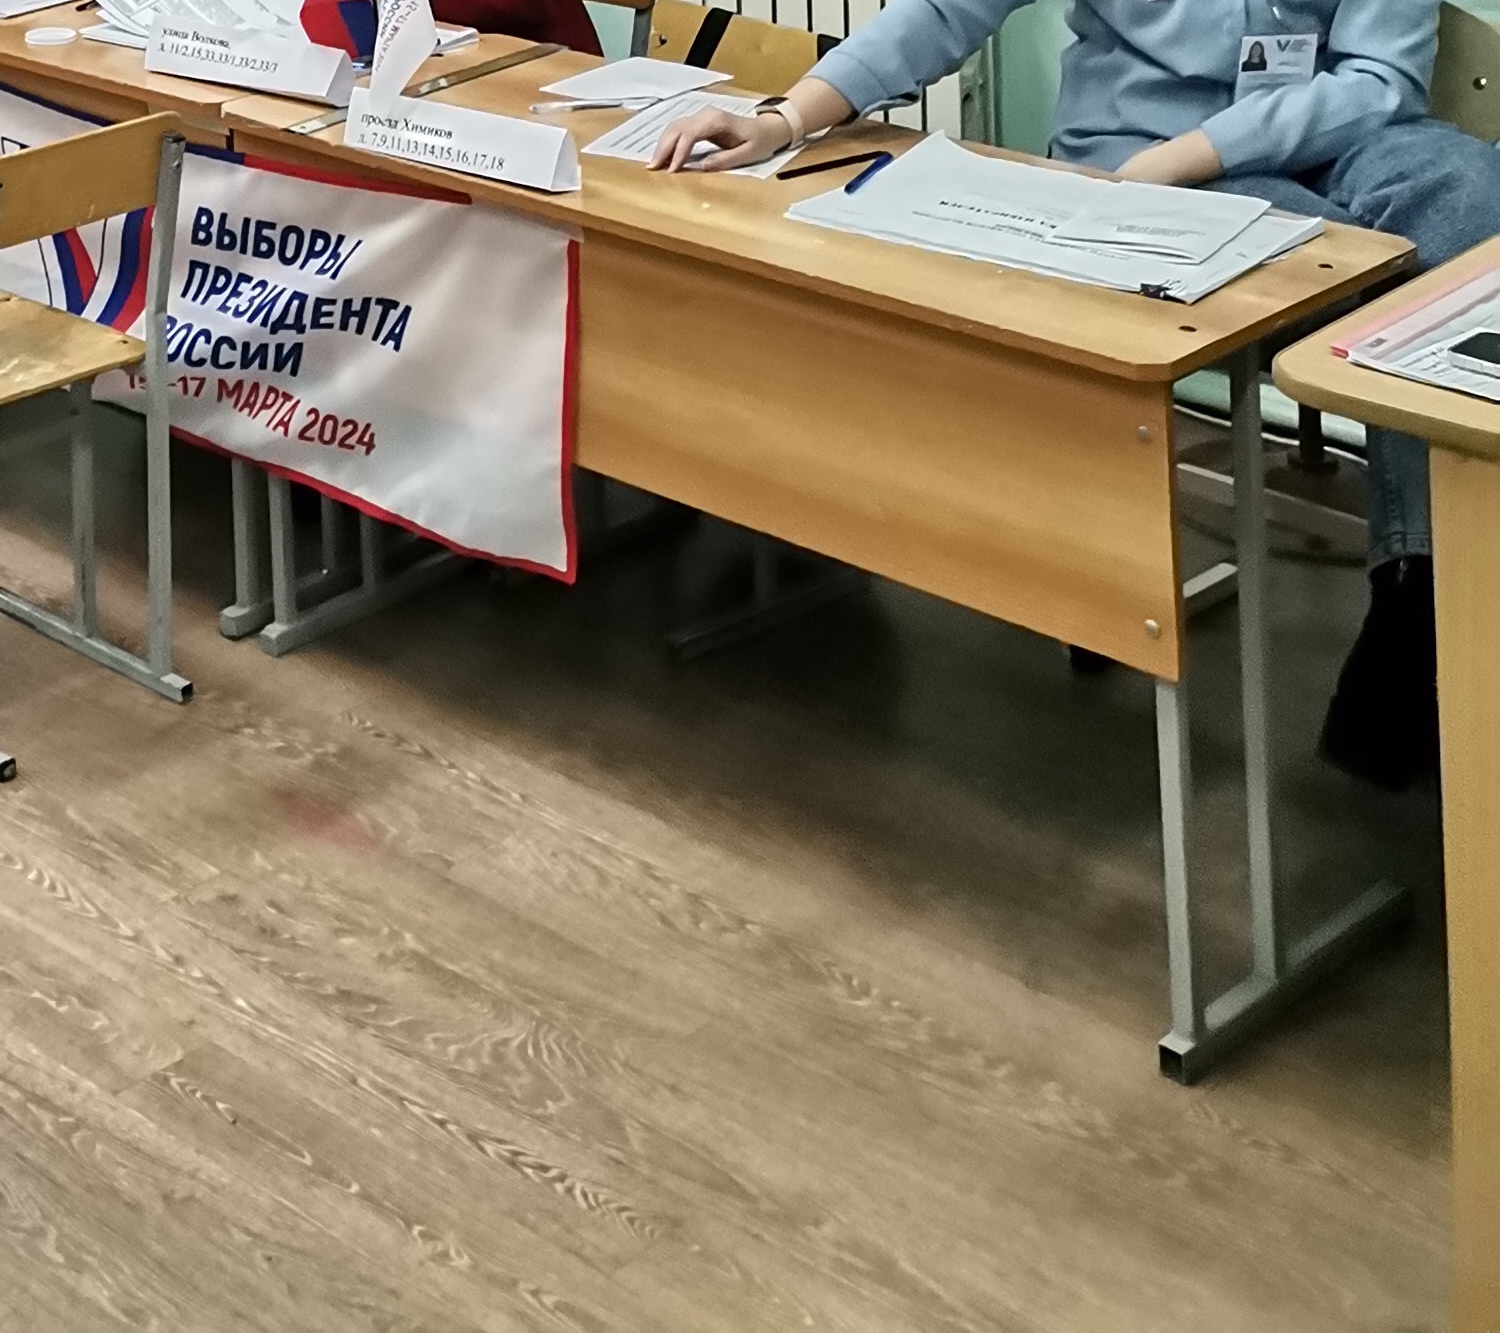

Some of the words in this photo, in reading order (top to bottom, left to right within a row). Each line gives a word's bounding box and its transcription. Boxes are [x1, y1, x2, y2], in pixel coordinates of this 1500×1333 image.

[400, 117, 453, 140] Химиков
[191, 206, 364, 280] ВЫБОРЫ
[180, 259, 412, 352] ПРЕЗИДЕНТА
[216, 378, 301, 438] МАРТА
[297, 407, 377, 456] 2024
